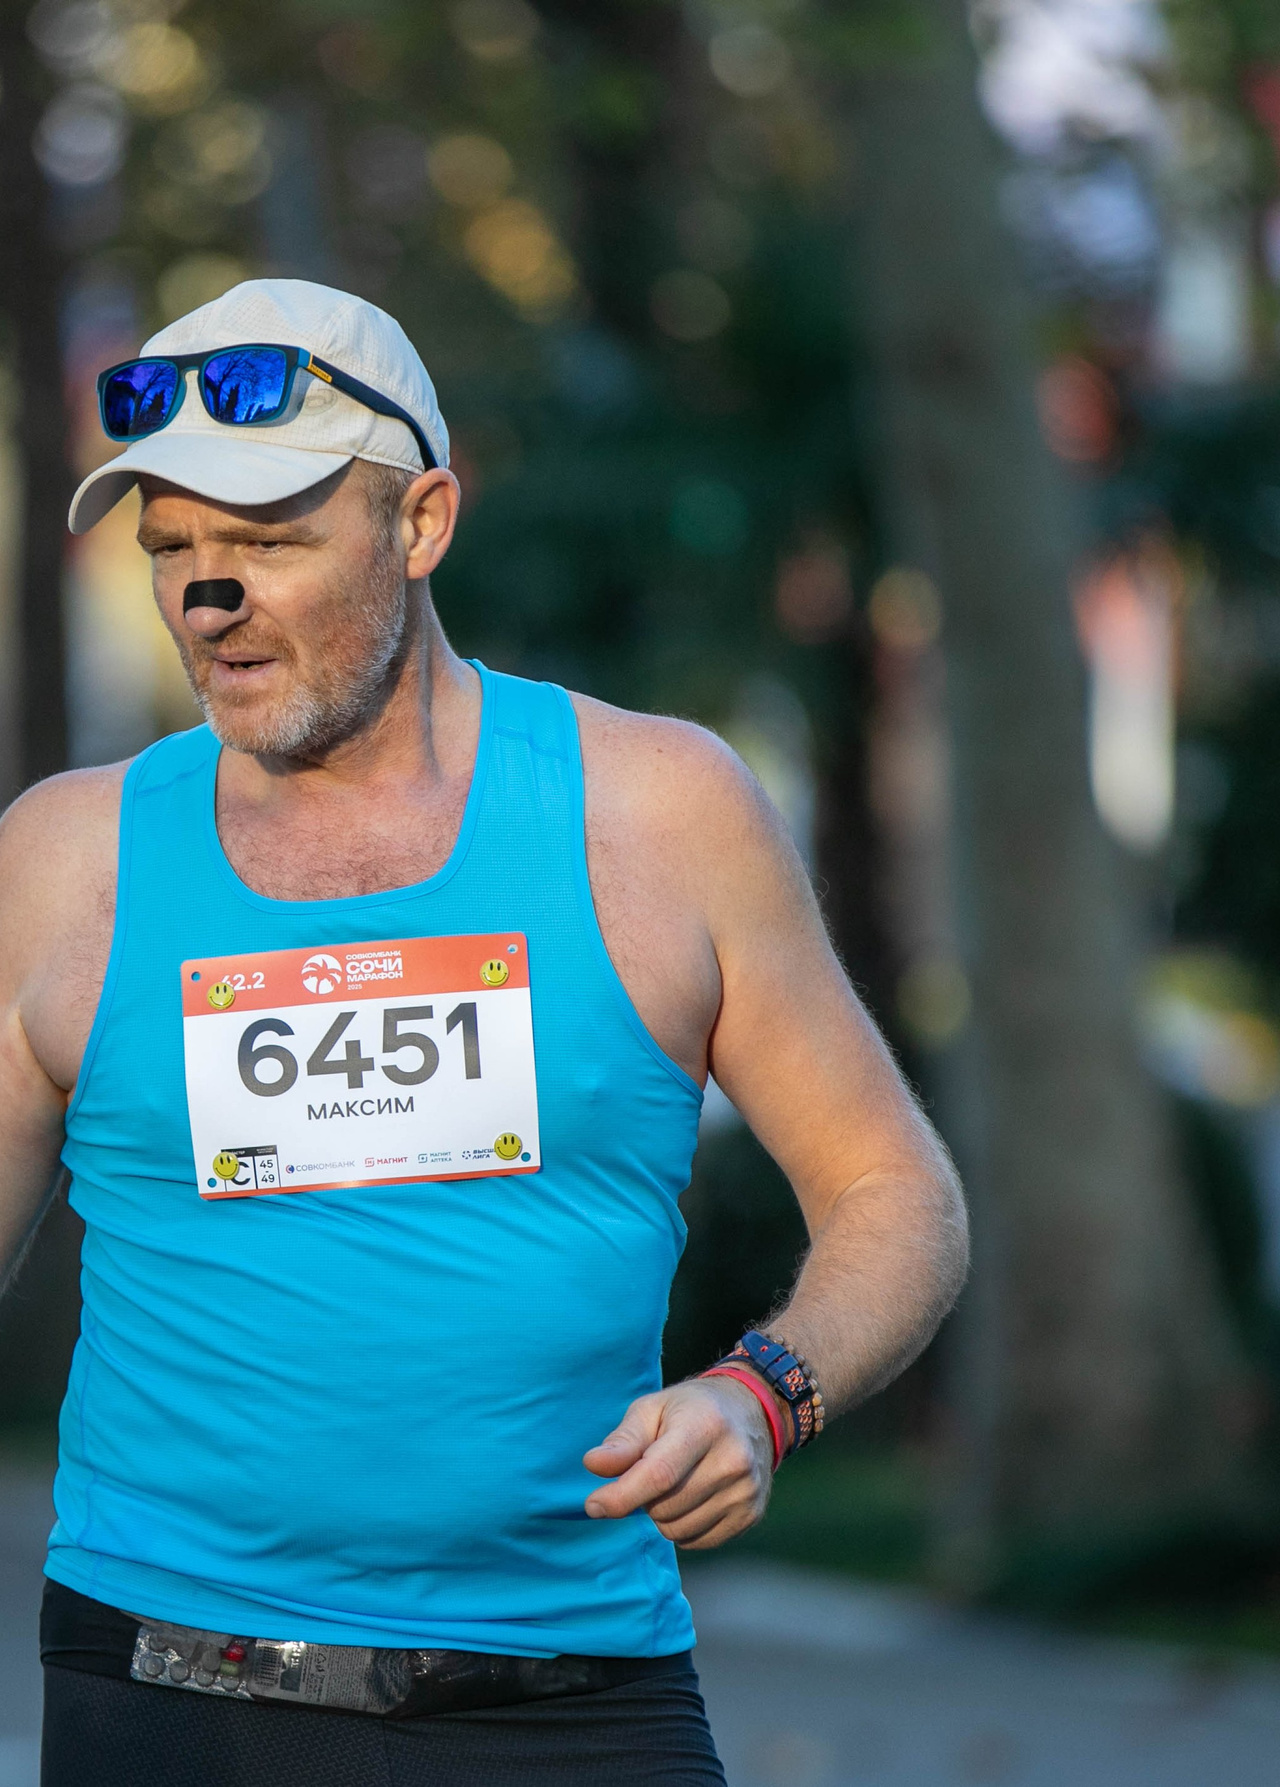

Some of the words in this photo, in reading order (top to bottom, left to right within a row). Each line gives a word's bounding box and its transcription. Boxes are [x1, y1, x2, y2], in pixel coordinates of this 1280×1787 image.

[345, 950, 402, 961] СОВКОМБАНК
[345, 957, 403, 975] СОЧИ
[346, 971, 403, 983] МАРАФОН
[347, 983, 363, 991] 2025
[237, 1002, 482, 1097] 6451
[307, 1096, 415, 1121] МАКСИМ
[259, 1159, 274, 1169] 45
[296, 1160, 356, 1172] СОВКОМБАНК
[377, 1156, 408, 1165] МАГНИТ
[261, 1173, 275, 1183] 49
